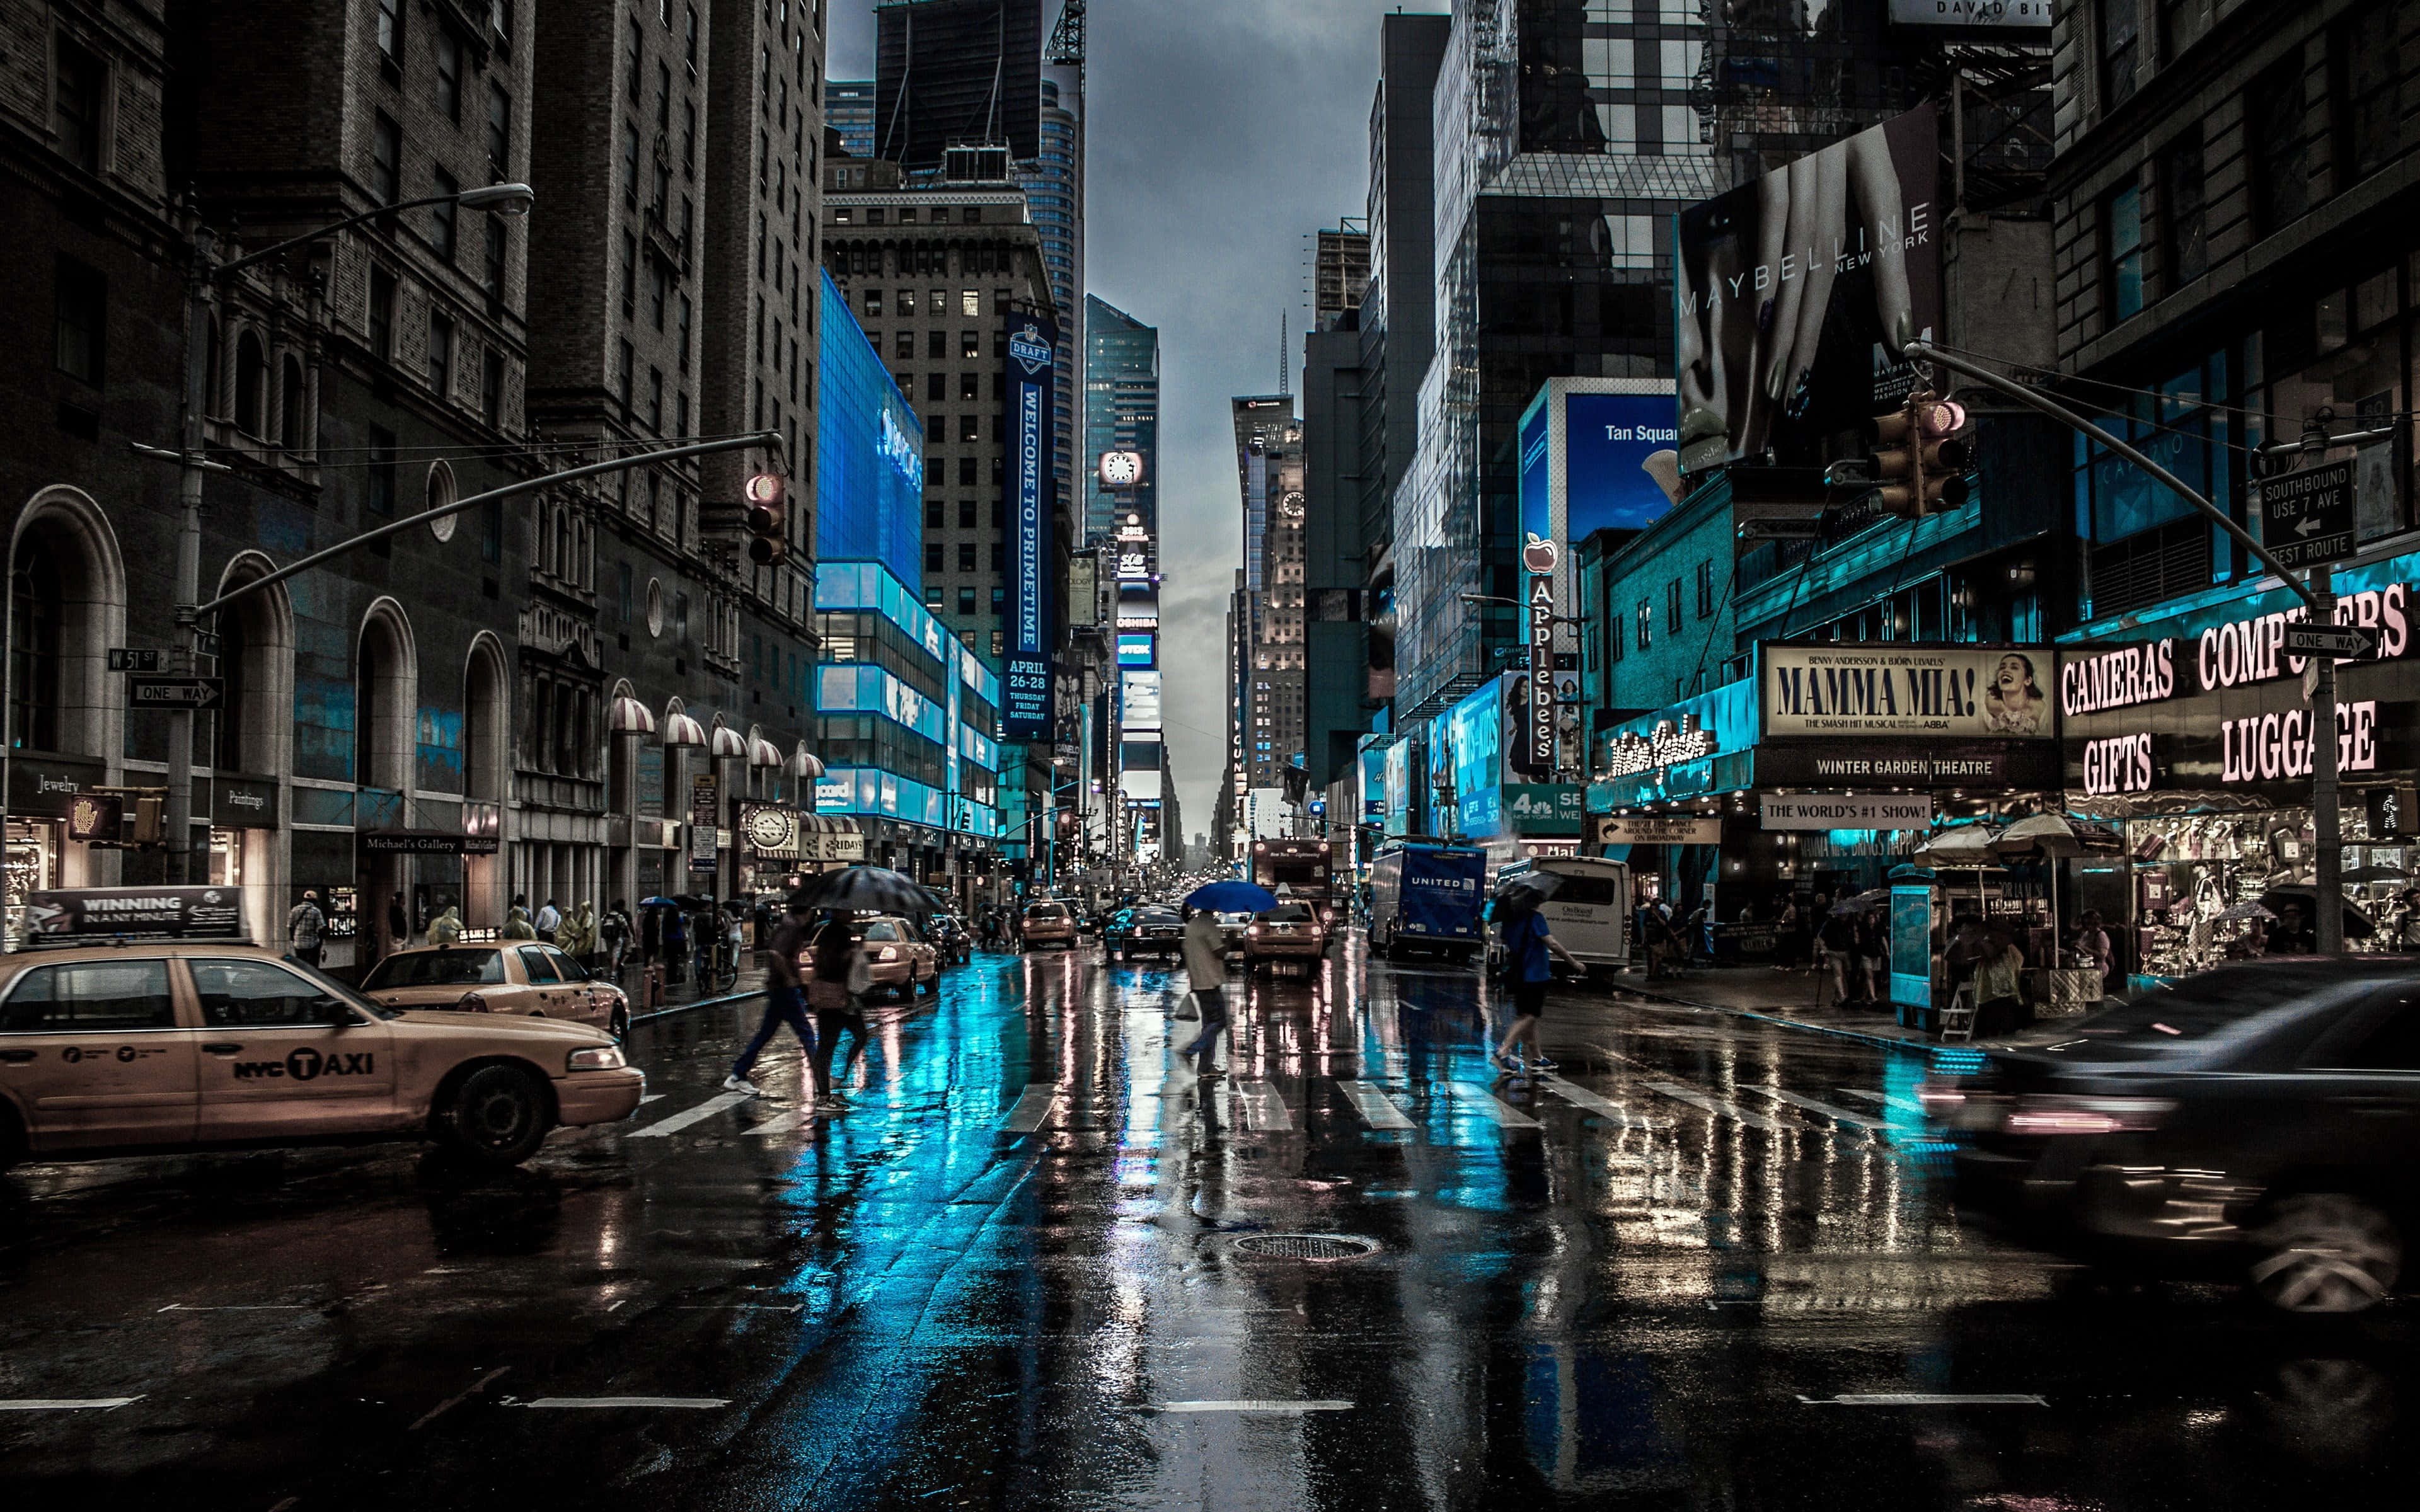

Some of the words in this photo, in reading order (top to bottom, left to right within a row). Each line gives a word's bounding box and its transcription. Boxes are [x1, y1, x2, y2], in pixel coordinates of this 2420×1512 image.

[1937, 1, 2002, 14] DAVID
[2020, 3, 2051, 15] BIT
[1680, 202, 1929, 319] MAYBELLINE
[1835, 252, 1871, 274] NEW
[1879, 231, 1929, 258] YORK
[1013, 343, 1047, 359] DRAFT
[1024, 391, 1037, 489] WELCOME
[1605, 425, 1632, 440] Tan
[1636, 425, 1677, 444] Squar
[2266, 469, 2347, 501] SOUTHBOUND
[1024, 495, 1035, 521] TO
[2273, 500, 2297, 518] USE
[2303, 496, 2310, 512] 7
[2317, 490, 2340, 509] AVE
[2270, 547, 2300, 564] BEST
[2307, 537, 2348, 559] ROUTE
[1024, 527, 1037, 645] PRIMETIME
[1116, 618, 1158, 627] OSHIBA
[2061, 638, 2174, 716] CAMERAS
[2199, 583, 2409, 691] COMPUERS
[2296, 634, 2324, 647] ONE
[2335, 636, 2363, 650] WAY
[111, 651, 123, 669] W
[127, 651, 139, 669] 51
[143, 651, 156, 661] ST
[1010, 660, 1046, 675] APRIL
[1531, 581, 1553, 757] Applebee's
[1809, 656, 1833, 665] BENNY
[1833, 656, 1878, 665] ANDERSSON
[1880, 657, 1886, 665] &
[1010, 675, 1046, 689] 26-28
[144, 687, 171, 699] ONE
[182, 687, 209, 700] WAY
[1010, 692, 1046, 701] THURSDAY
[1777, 667, 1898, 716] MAMMA
[1906, 668, 1976, 717] MIA!
[1010, 712, 1045, 720] SATURDAY
[1805, 719, 1820, 728] THE
[1821, 719, 1848, 728] SMASH
[1850, 719, 1862, 728] HIT
[1865, 720, 1898, 729] MUSICAL
[1923, 721, 1947, 729] ABBA
[1479, 704, 1498, 759] KIDS
[1056, 744, 1080, 754] CANELO
[1817, 760, 1870, 774] WINTER
[1874, 760, 1928, 775] GARDEN
[1933, 760, 1993, 776] THEATRE
[2083, 733, 2152, 796] GIFTS
[37, 774, 79, 794] Jewelry
[229, 789, 264, 811] Paintings
[1513, 793, 1531, 814] 4
[1560, 793, 1581, 806] SE
[1560, 811, 1581, 820] WE
[1769, 805, 1794, 818] THE
[1798, 805, 1857, 818] WORLD'S
[1861, 805, 1876, 818] #1
[1882, 805, 1926, 818] SHOW!
[367, 839, 415, 849] Michael's
[418, 839, 456, 852] Gallery
[1412, 877, 1460, 888] UNITED
[83, 897, 182, 911] WINNING
[234, 1062, 284, 1078] NYC
[287, 1047, 373, 1081] TAXI
